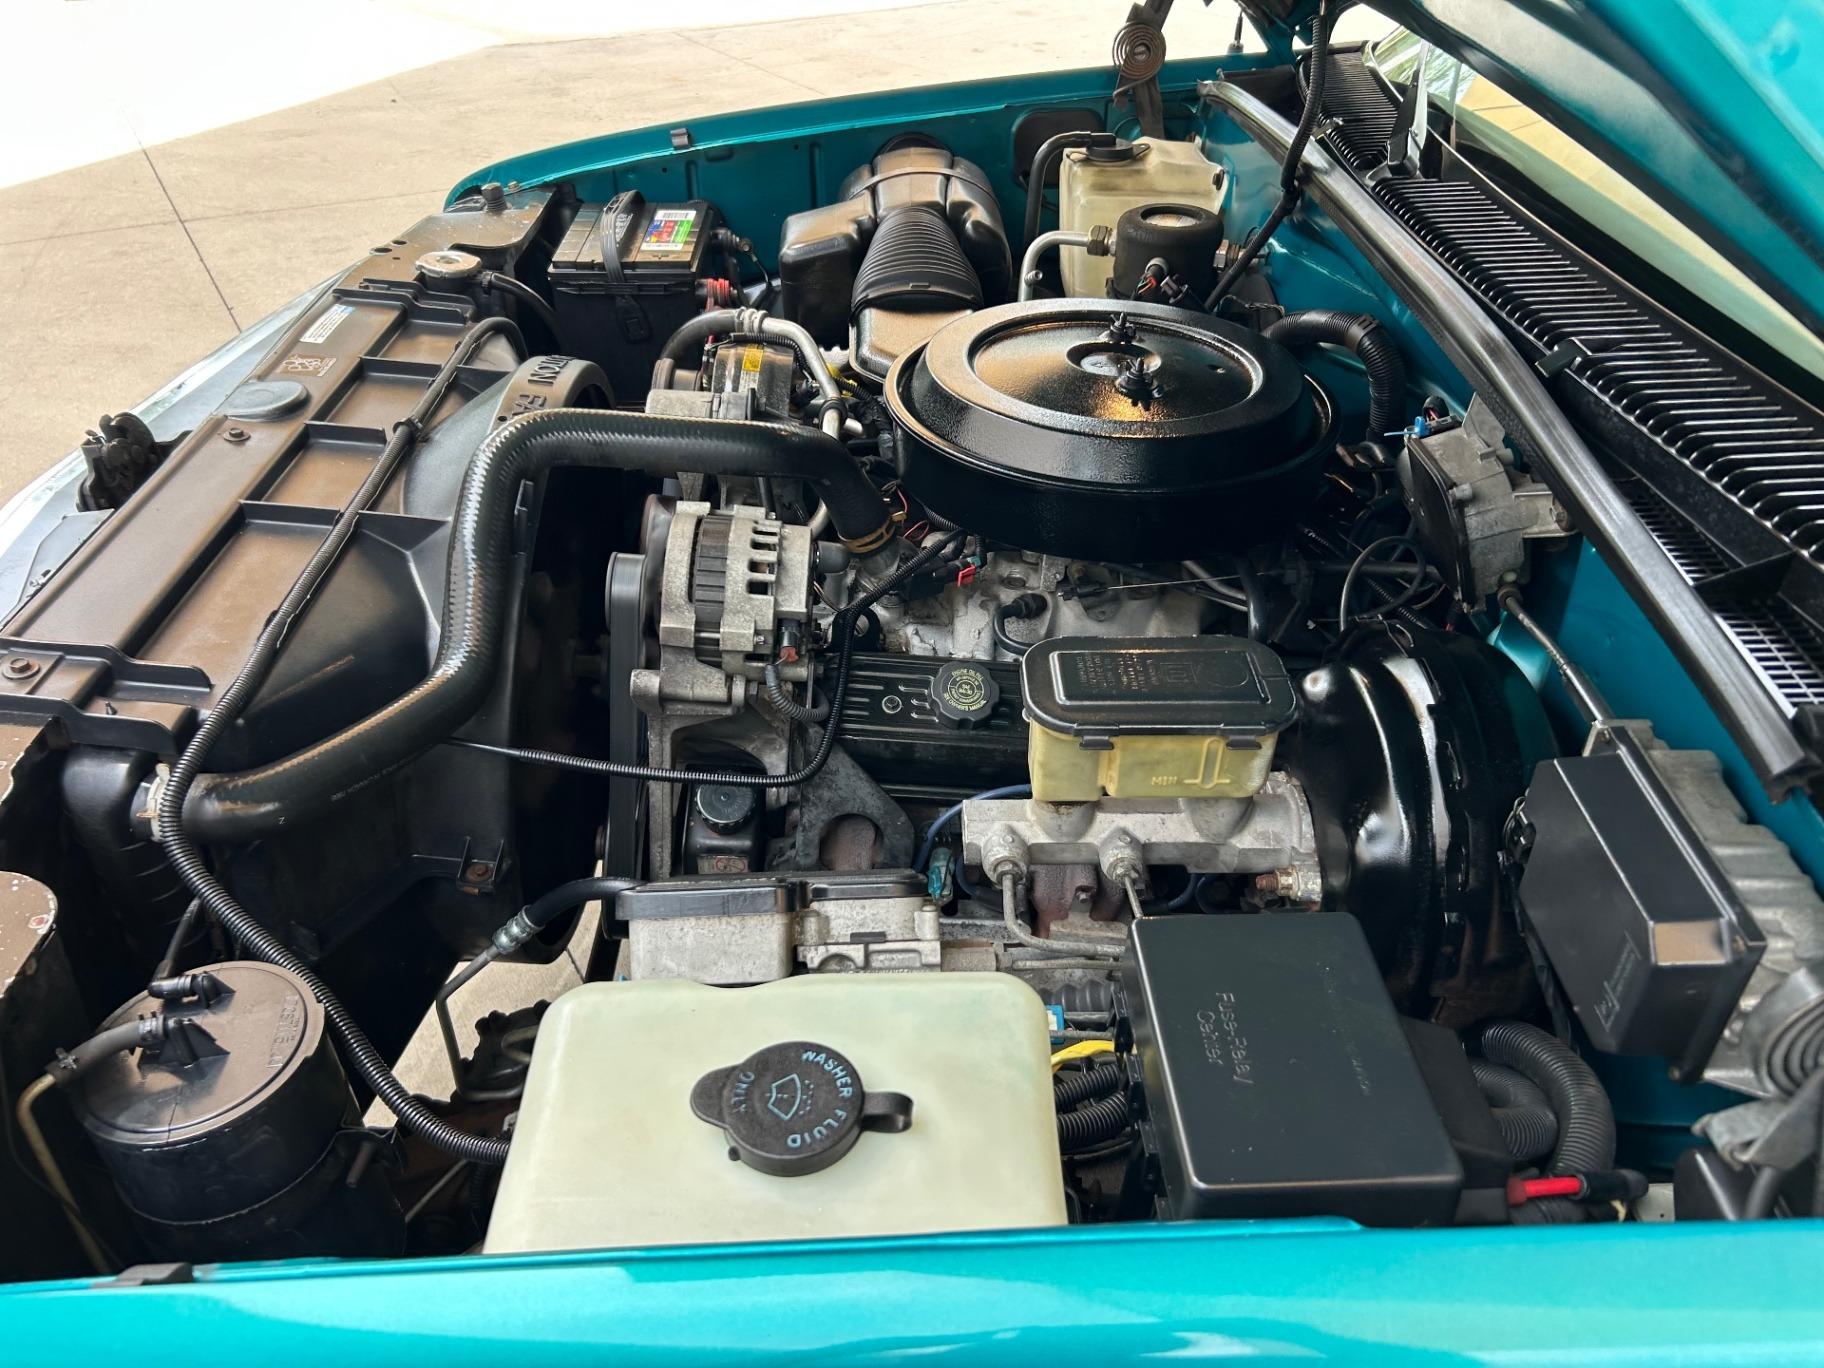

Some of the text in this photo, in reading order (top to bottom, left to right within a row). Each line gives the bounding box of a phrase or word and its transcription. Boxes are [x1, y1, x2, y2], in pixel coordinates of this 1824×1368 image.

[512, 393, 547, 416] FA
[1151, 776, 1178, 786] MIN
[731, 1050, 853, 1148] WASHER FLUID ONLY
